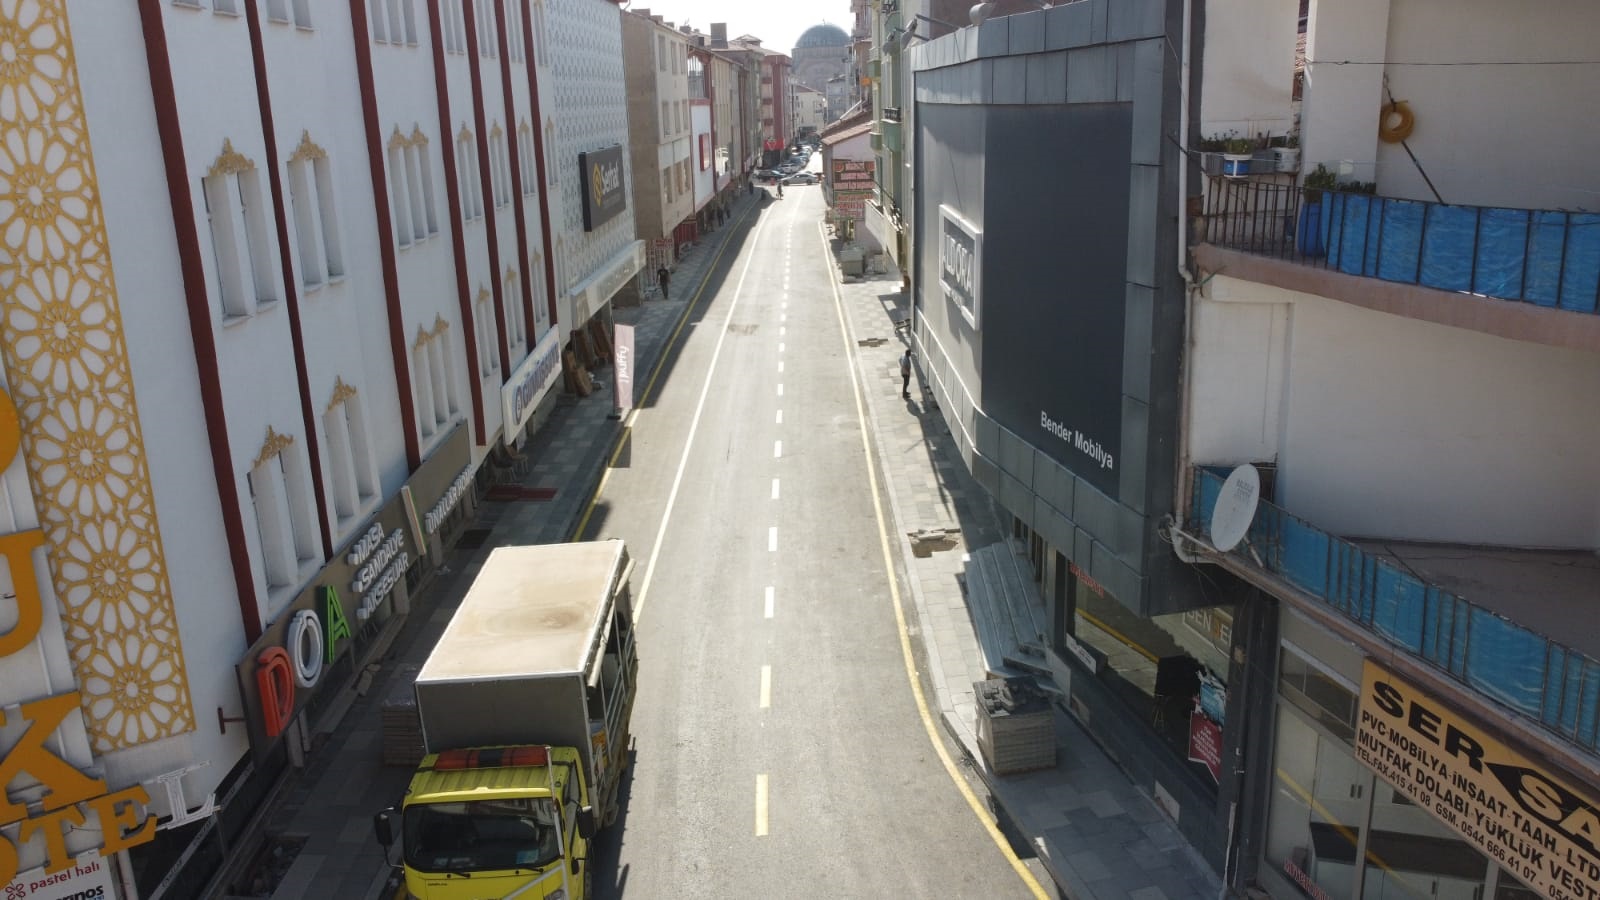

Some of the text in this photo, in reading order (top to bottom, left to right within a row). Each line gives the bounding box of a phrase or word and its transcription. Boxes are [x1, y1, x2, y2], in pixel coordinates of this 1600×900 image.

[1041, 411, 1114, 470] Bender Mobilya
[357, 522, 385, 564] MASA
[359, 528, 405, 589] SANDALYE
[364, 552, 409, 617] AKSESUAR
[257, 585, 351, 737] DOA
[1359, 728, 1412, 776] MUTFAK
[1474, 808, 1545, 870] YÜKLÜK
[1408, 784, 1418, 798] 41
[1420, 793, 1431, 807] 08
[1435, 802, 1459, 827] GSM.
[1461, 821, 1485, 846] 0544
[1487, 841, 1505, 861] 666
[1507, 857, 1521, 871] 41
[1523, 867, 1537, 882] 07
[29, 868, 72, 893] pastel
